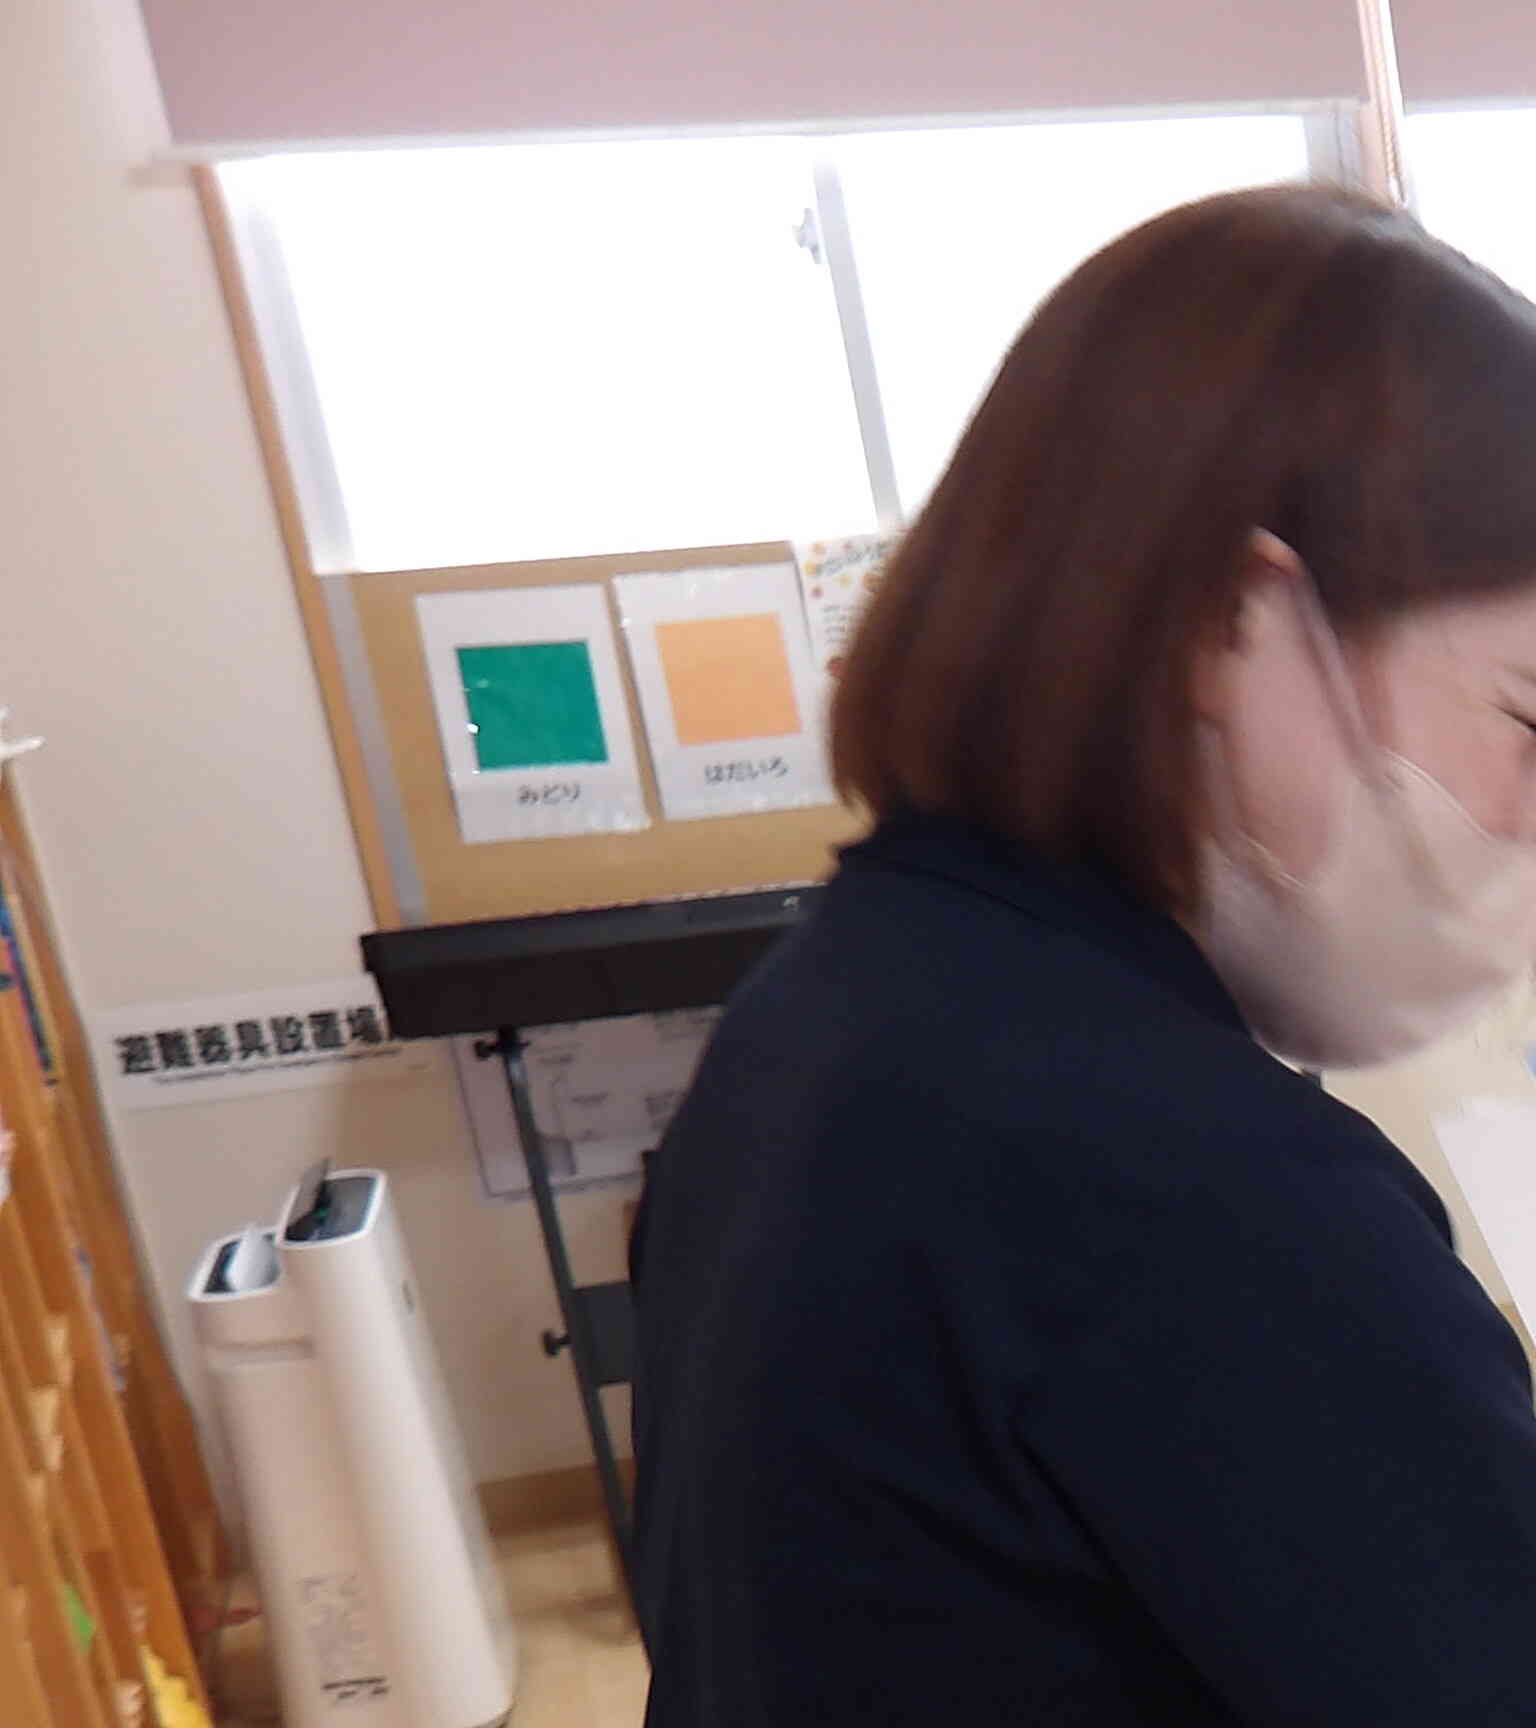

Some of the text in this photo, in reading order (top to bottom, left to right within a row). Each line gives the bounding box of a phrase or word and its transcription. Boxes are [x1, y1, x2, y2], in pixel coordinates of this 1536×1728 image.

[704, 756, 790, 784] はだいろ
[516, 780, 582, 806] みどり
